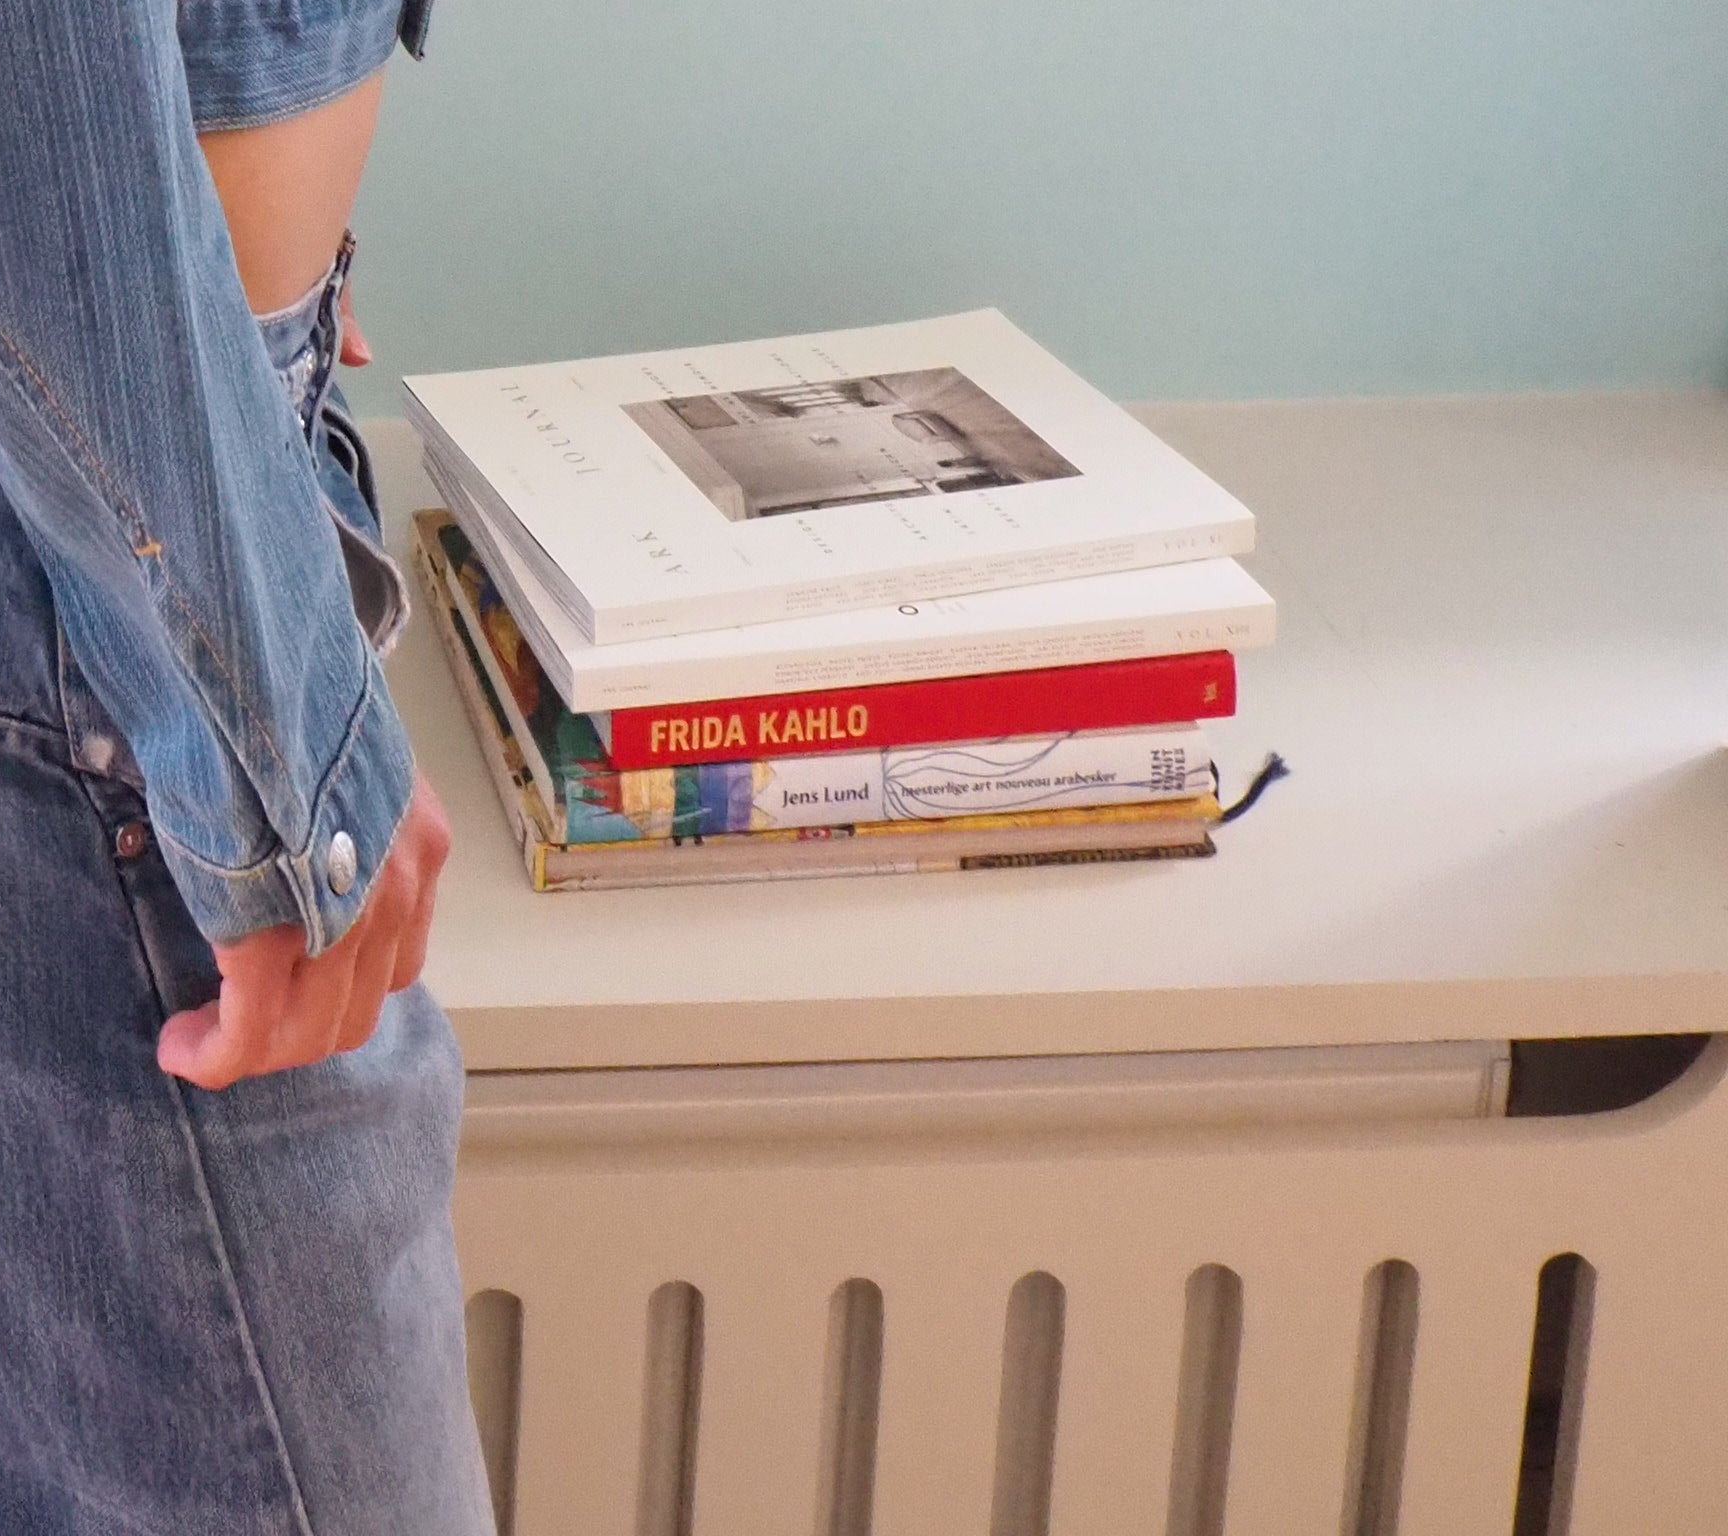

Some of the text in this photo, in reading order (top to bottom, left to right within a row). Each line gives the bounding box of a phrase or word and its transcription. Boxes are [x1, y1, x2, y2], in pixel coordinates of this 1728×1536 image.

[500, 383, 602, 475] JOURNAL
[632, 531, 688, 574] ARK
[650, 705, 868, 752] FRIDA KAHLO
[782, 783, 870, 808] Jens Lund
[901, 770, 1118, 798] mesterlige art nouveau arabesker
